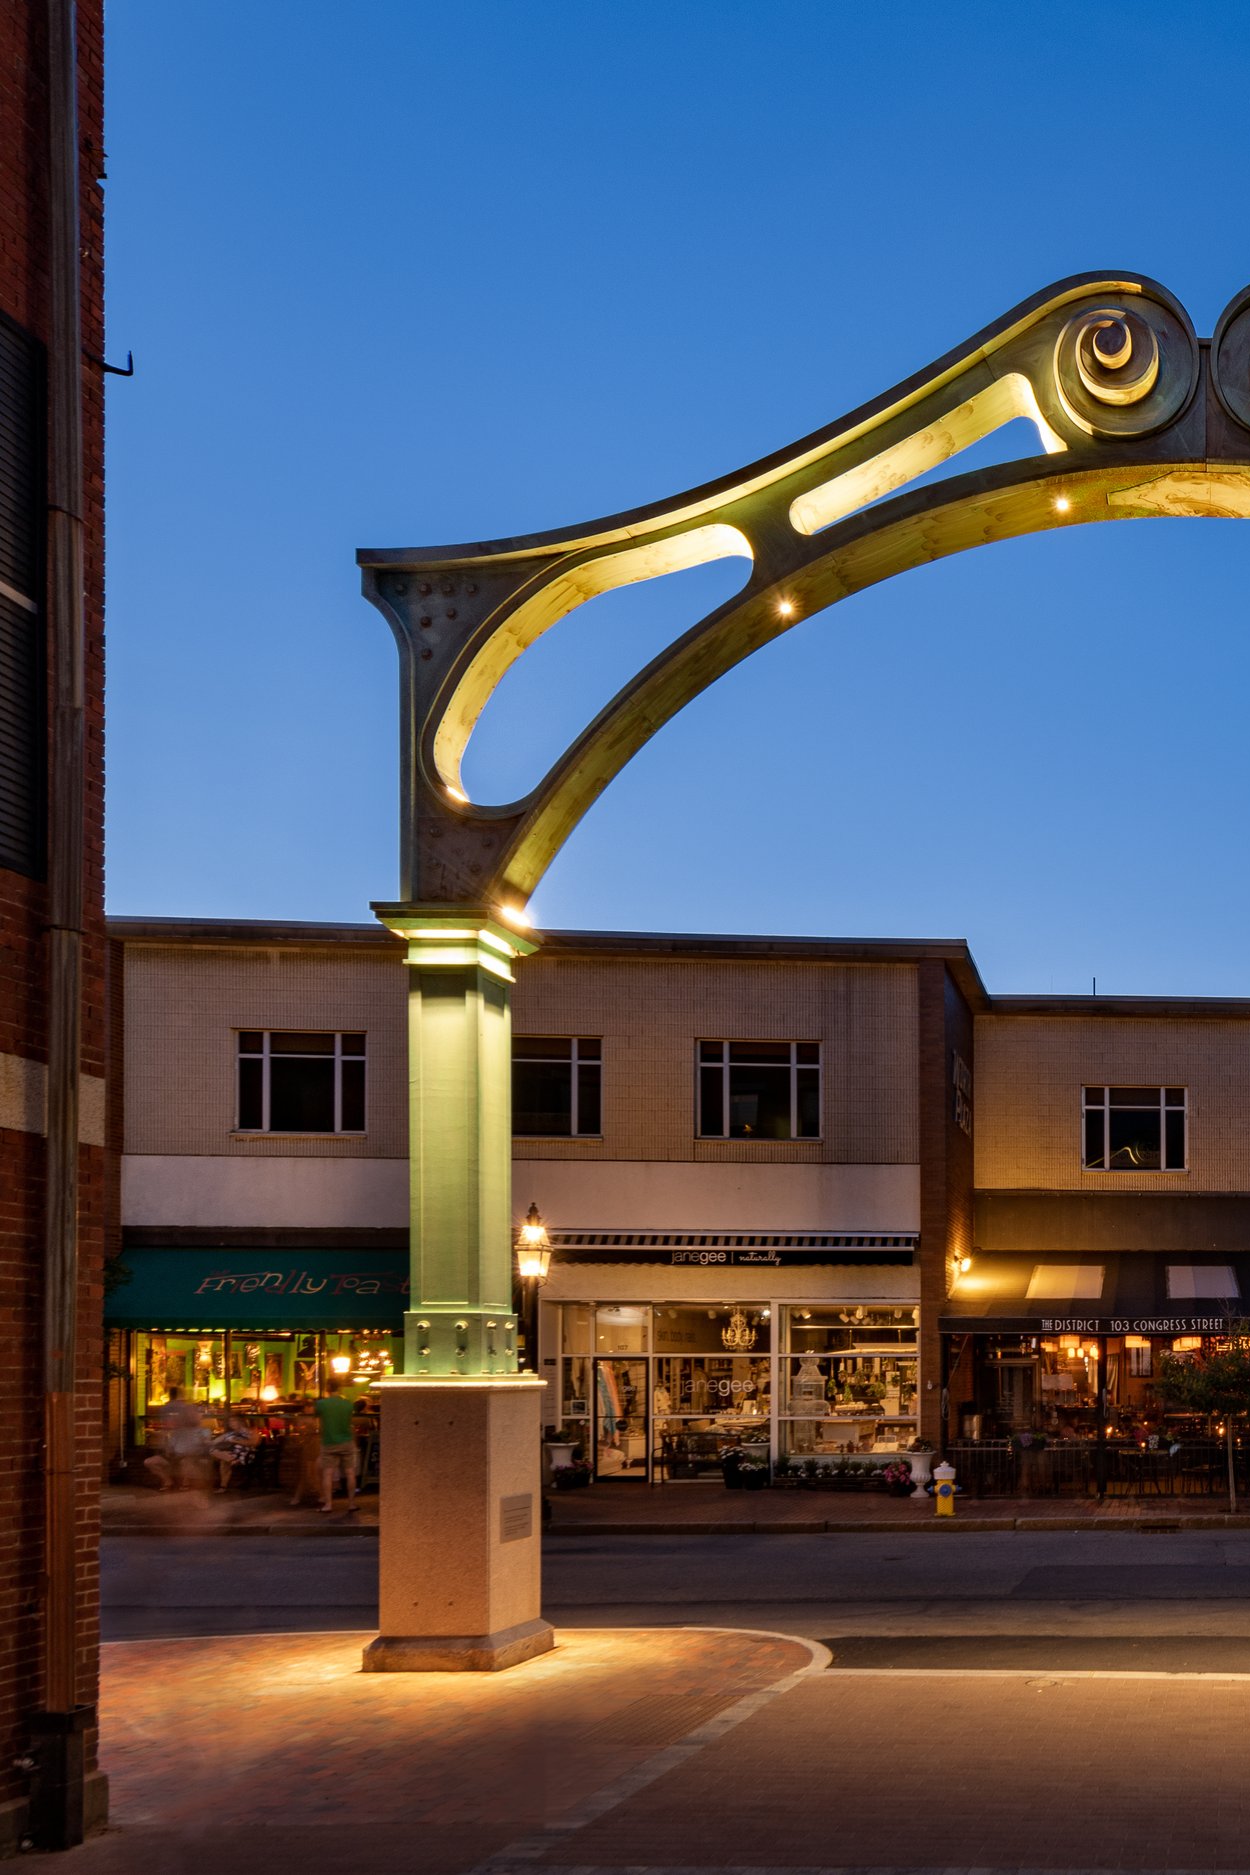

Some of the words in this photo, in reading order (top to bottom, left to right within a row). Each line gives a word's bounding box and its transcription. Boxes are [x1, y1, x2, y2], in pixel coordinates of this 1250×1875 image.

[671, 1250, 727, 1265] janegee
[738, 1250, 782, 1266] naturally
[1042, 1319, 1053, 1330] THE
[1054, 1319, 1100, 1331] DISTRICT
[1110, 1320, 1130, 1332] 103
[1133, 1319, 1187, 1332] CONGRESS
[1191, 1318, 1224, 1331] STREET
[680, 1379, 754, 1397] janegee
